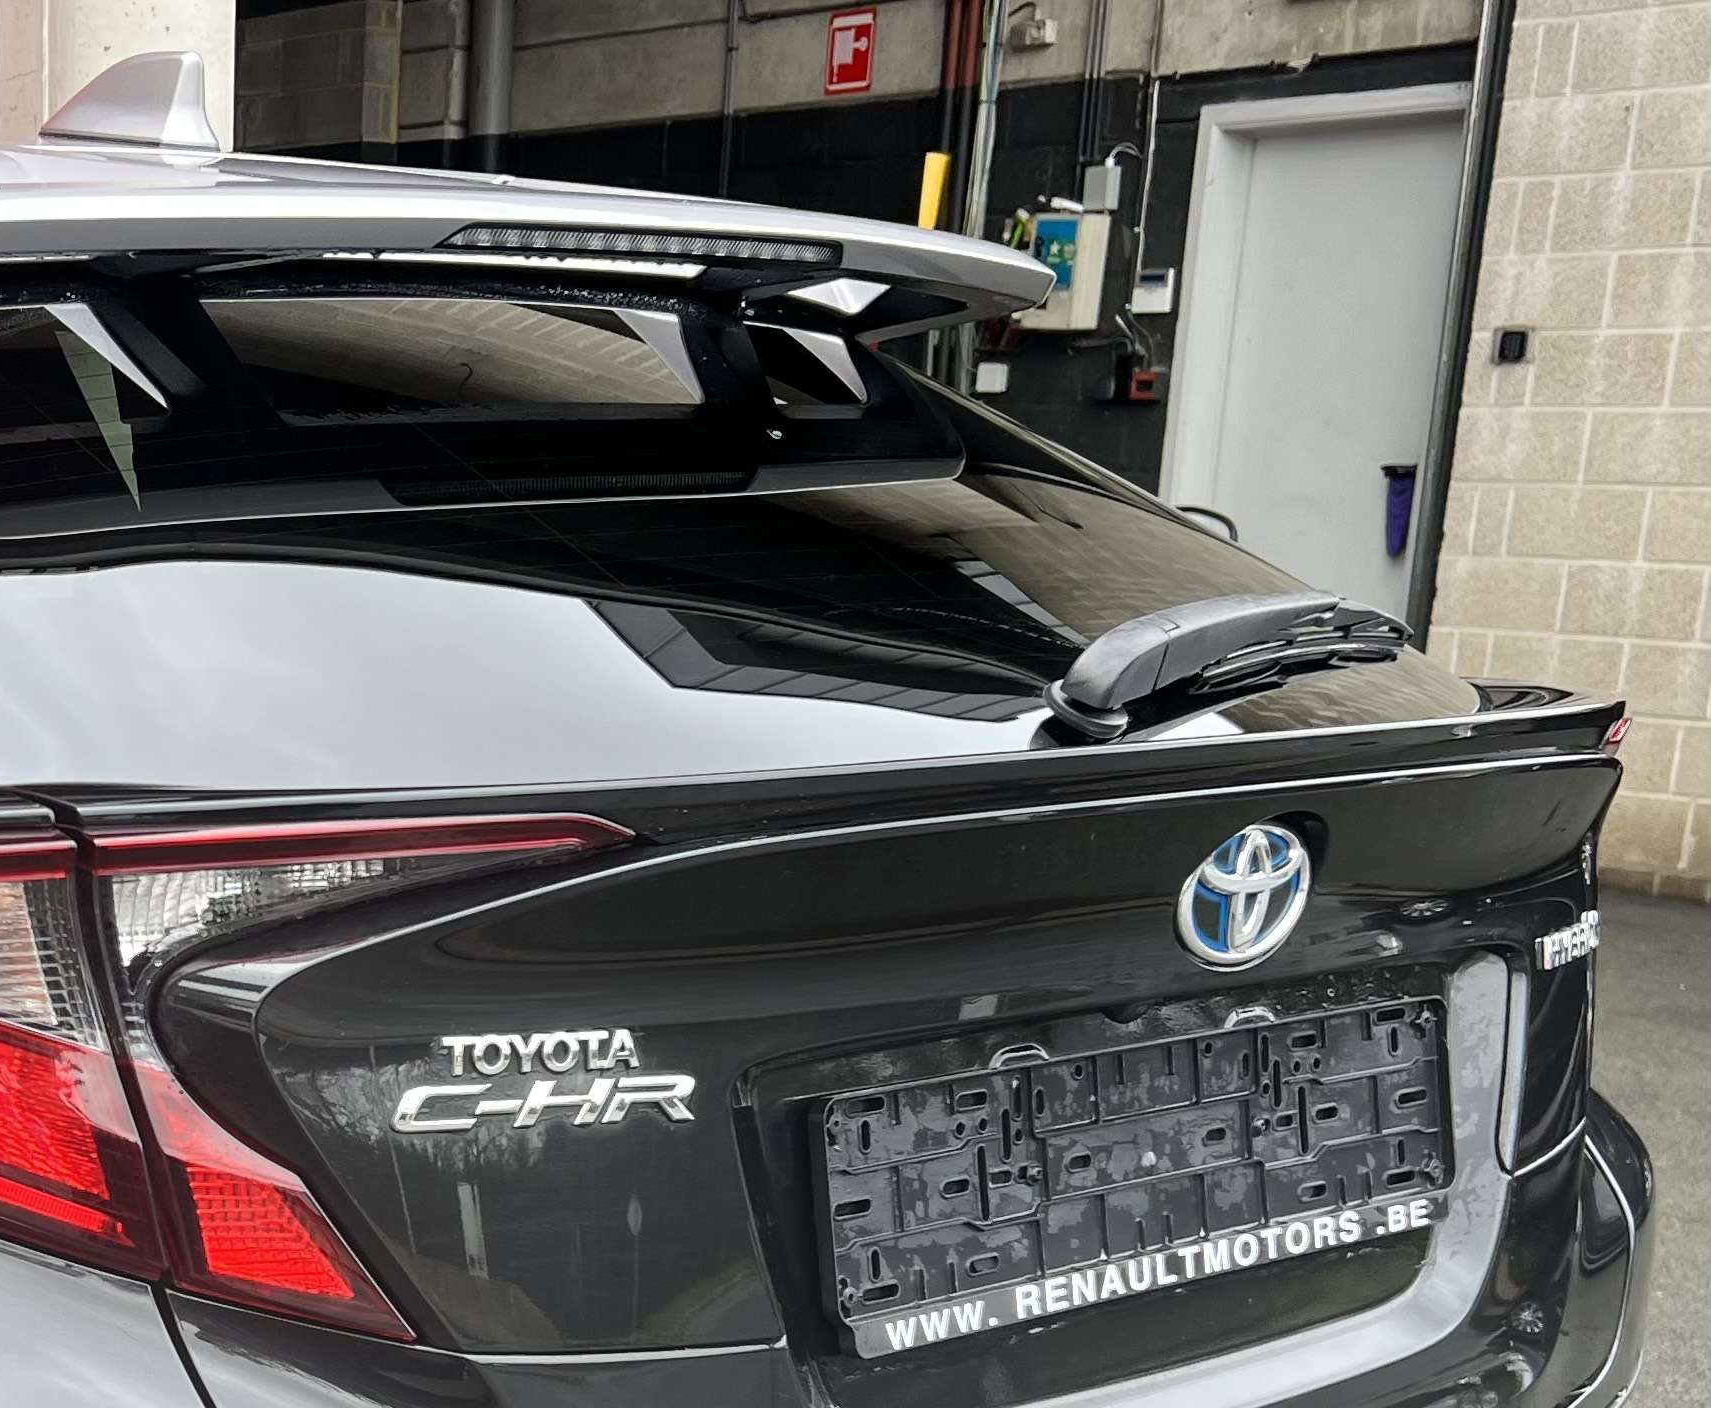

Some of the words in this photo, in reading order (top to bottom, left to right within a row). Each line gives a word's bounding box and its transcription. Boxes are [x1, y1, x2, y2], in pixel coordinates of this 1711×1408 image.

[441, 1028, 641, 1077] TOYOTA
[391, 1074, 696, 1133] C-HR
[885, 1301, 999, 1352] WWW.
[1015, 1210, 1362, 1321] RENAULTMOTORS
